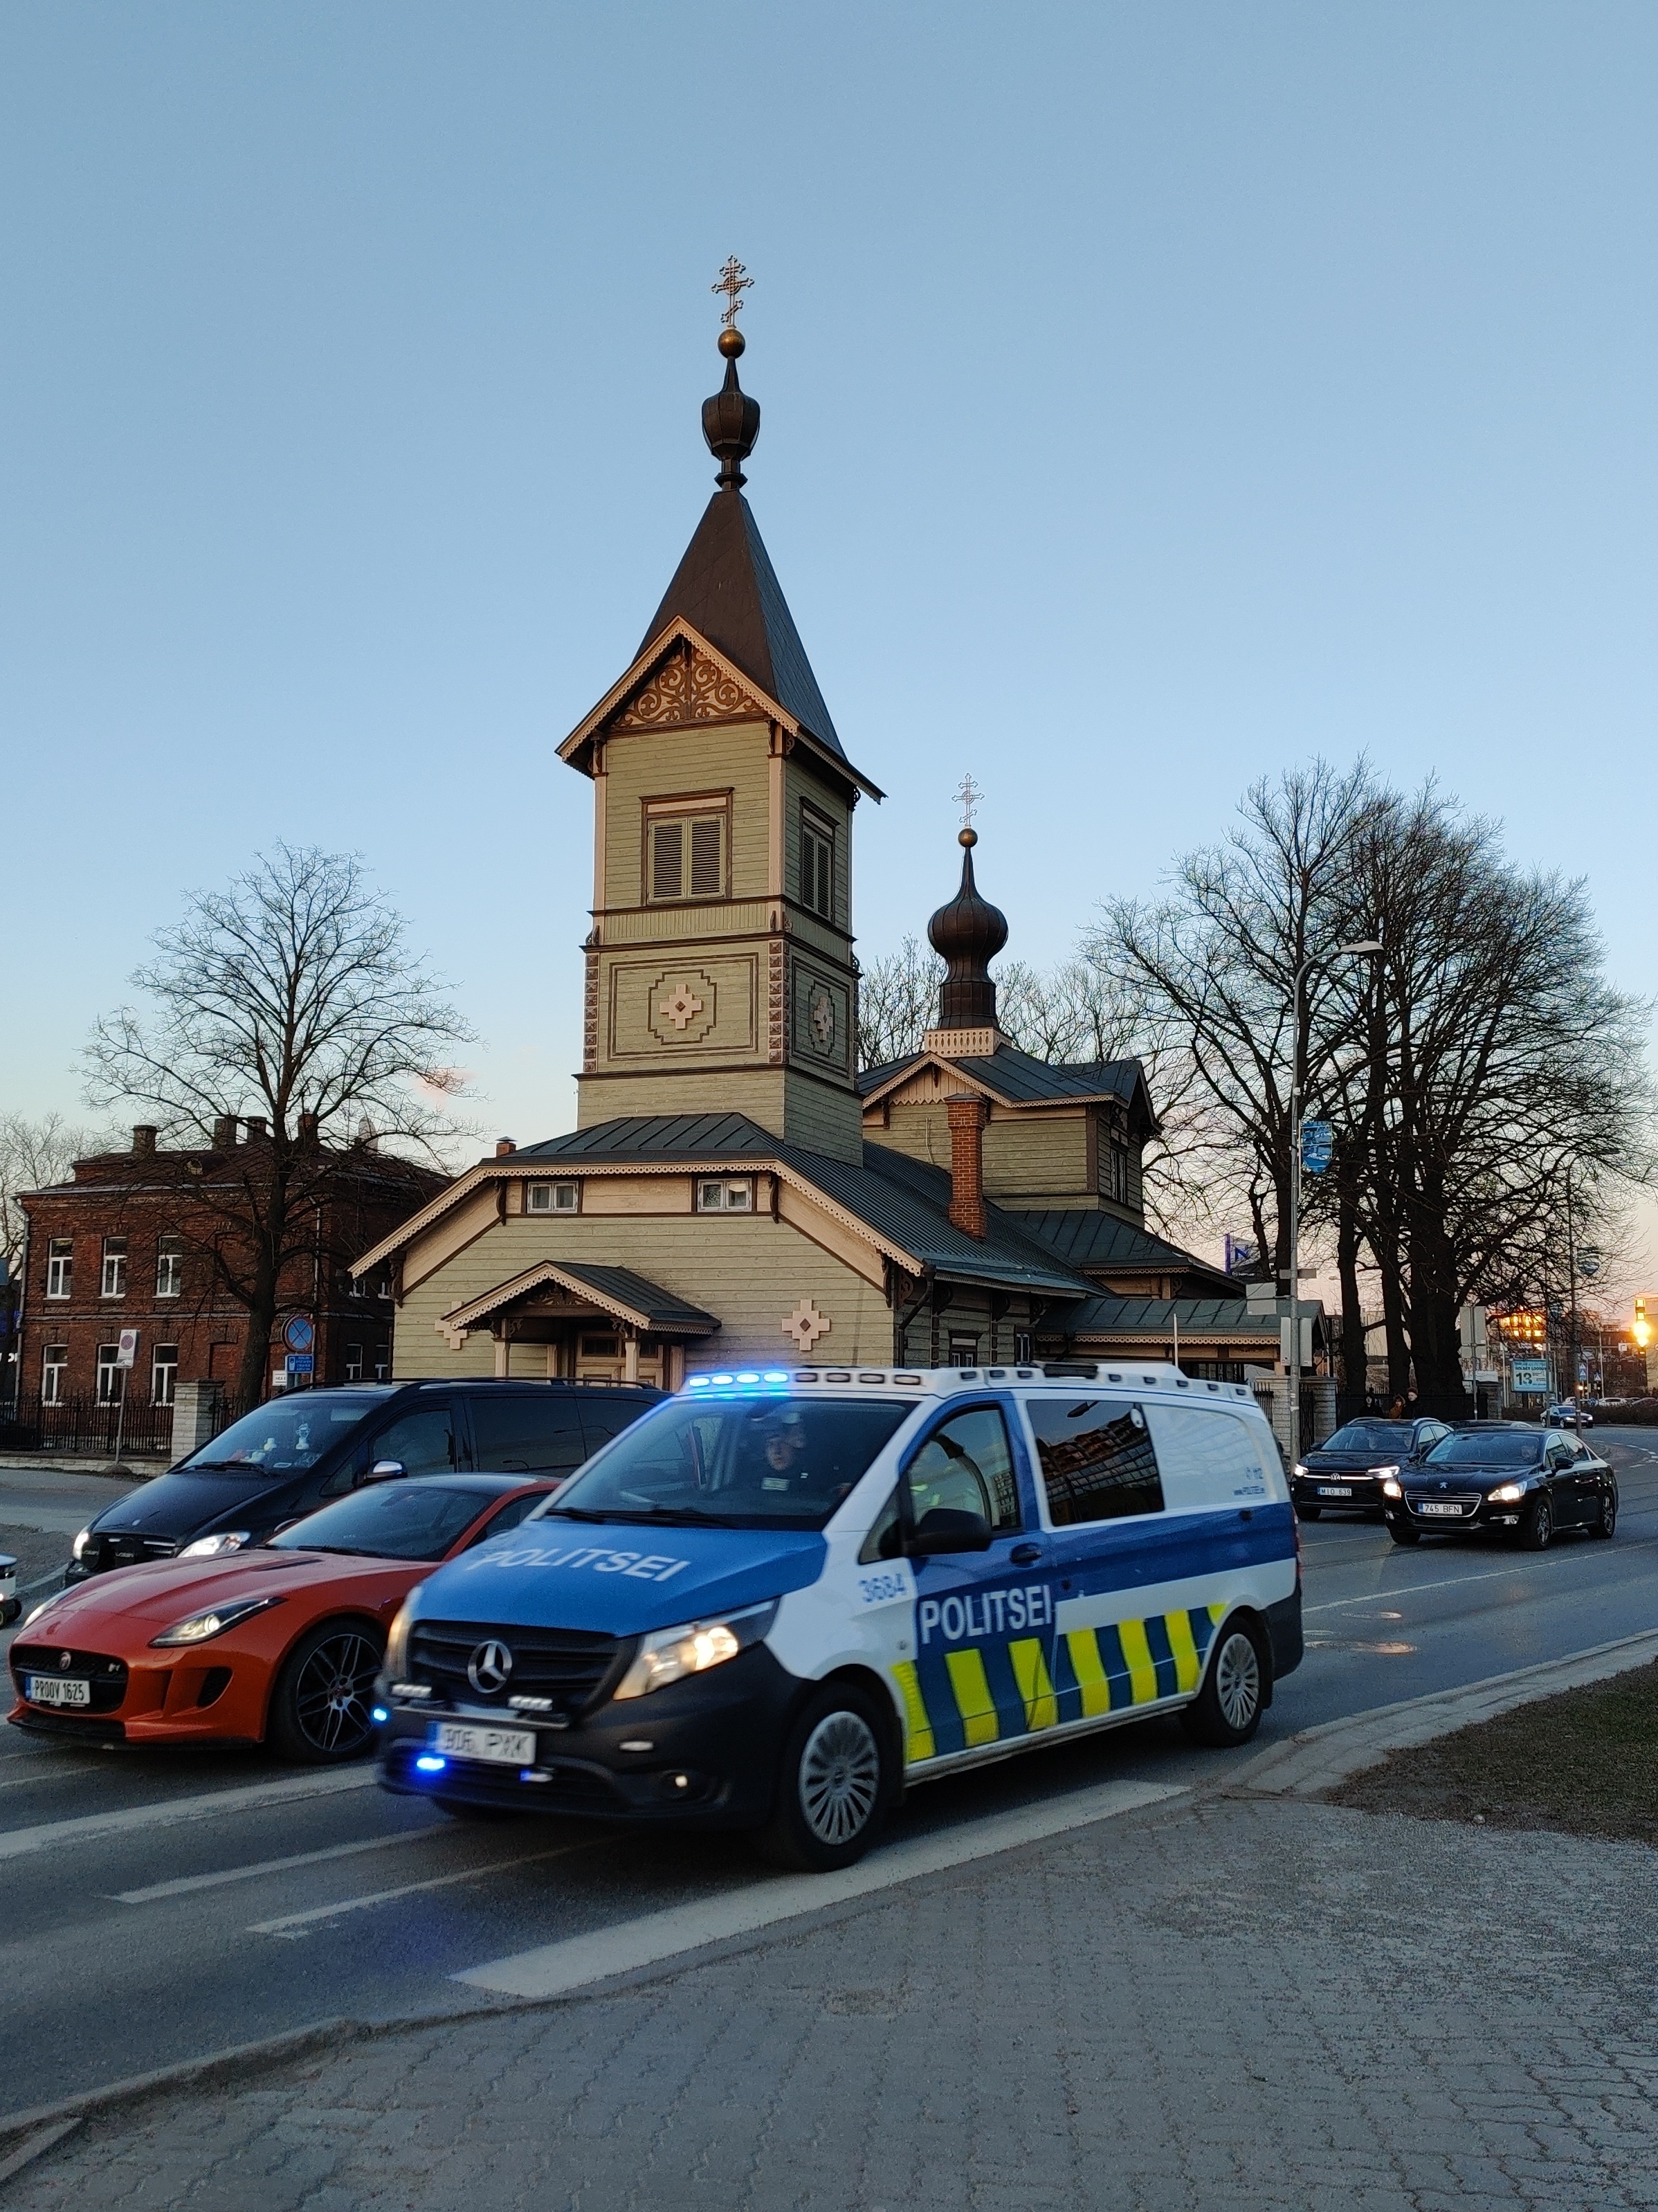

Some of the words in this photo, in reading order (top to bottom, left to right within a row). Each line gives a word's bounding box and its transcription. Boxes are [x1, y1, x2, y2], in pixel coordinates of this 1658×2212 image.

[1515, 1372, 1533, 1385] 13
[465, 1548, 691, 1581] POLITSEI
[920, 1584, 1052, 1644] POLITSEI
[35, 1680, 60, 1700] PROOV
